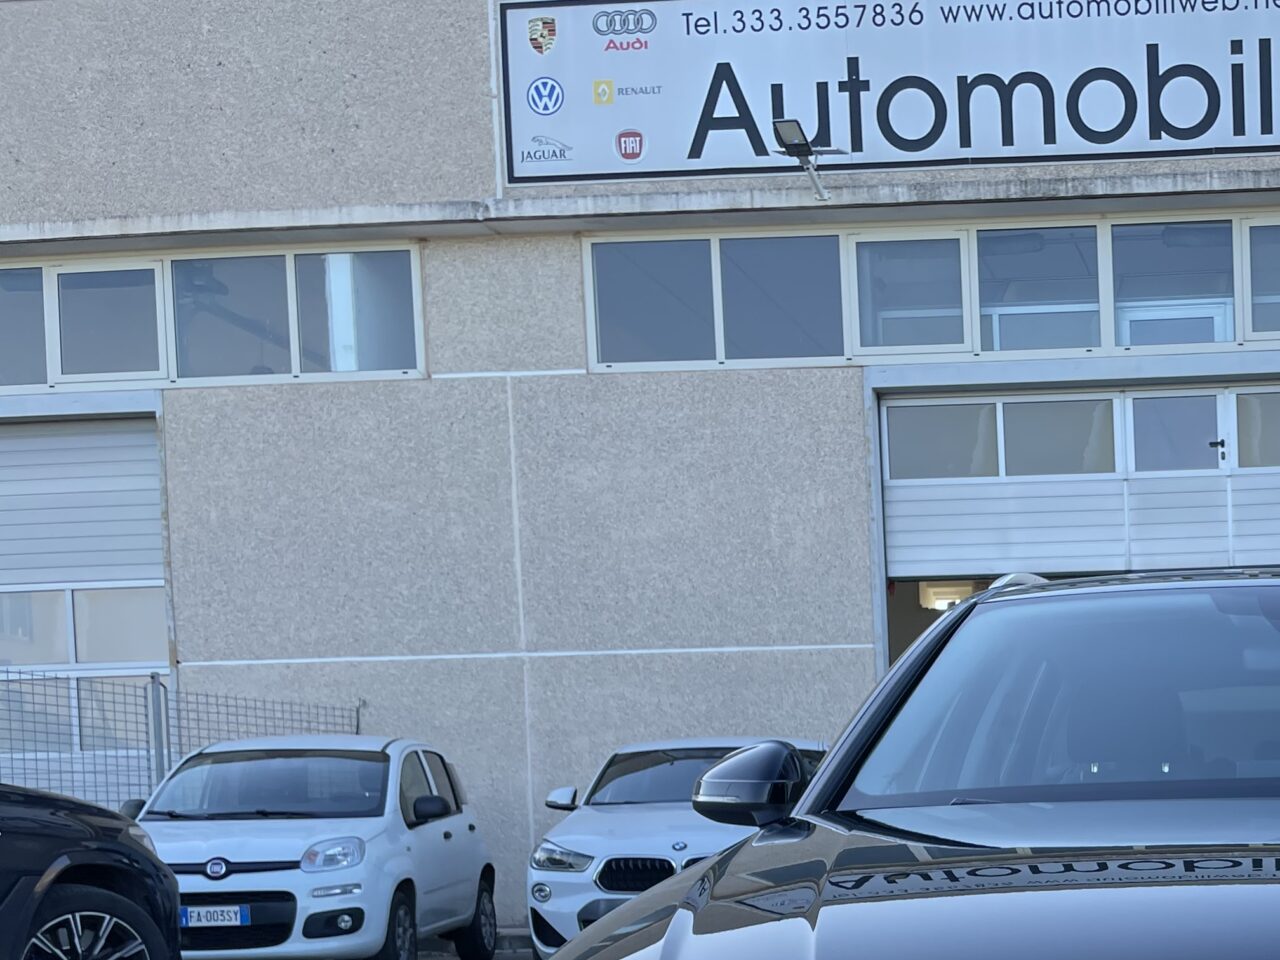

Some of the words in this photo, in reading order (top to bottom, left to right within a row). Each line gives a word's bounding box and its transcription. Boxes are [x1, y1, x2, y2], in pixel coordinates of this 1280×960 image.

[681, 2, 925, 36] Tel.333.3557836
[604, 37, 649, 52] Audi
[617, 85, 663, 97] RENAULT
[620, 136, 641, 154] FIAT
[521, 149, 567, 163] JAGUAR
